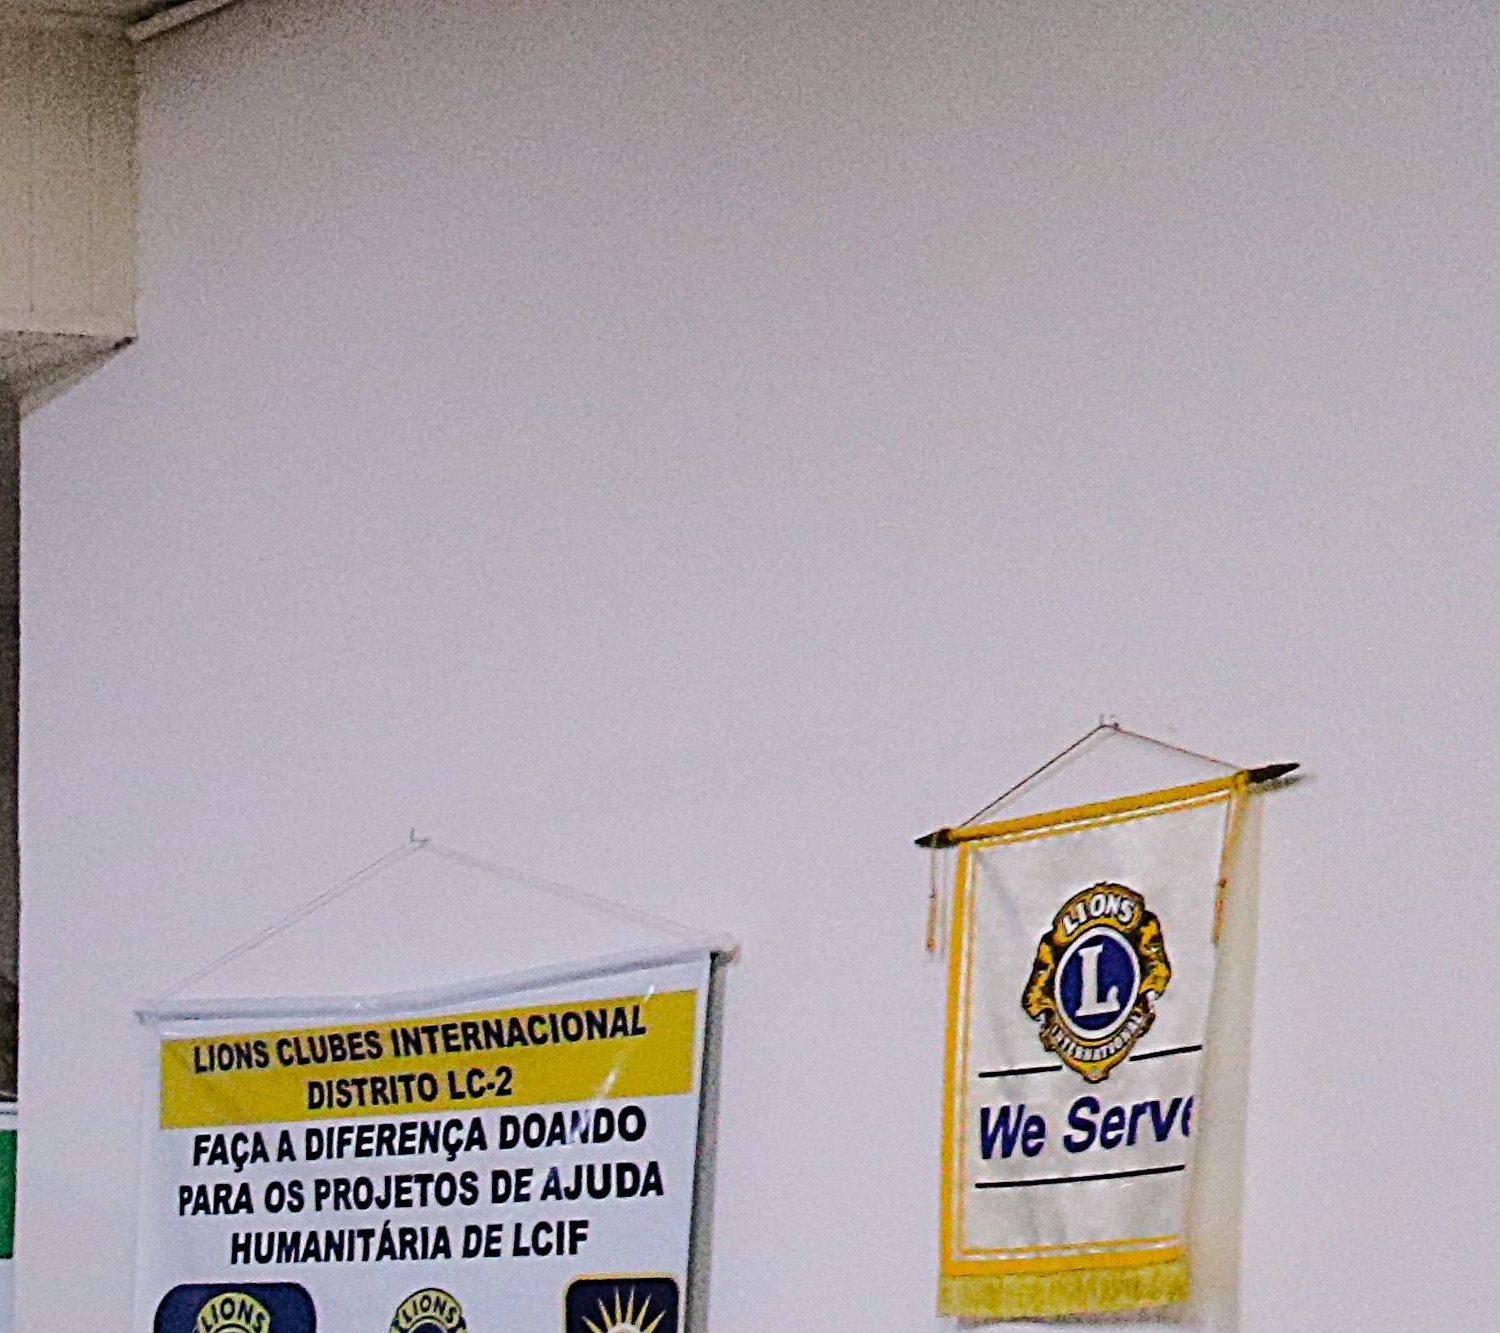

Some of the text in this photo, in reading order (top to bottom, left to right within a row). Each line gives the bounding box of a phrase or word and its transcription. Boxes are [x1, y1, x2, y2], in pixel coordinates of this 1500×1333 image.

[1062, 893, 1135, 935] LIONS
[1075, 943, 1120, 1018] L
[194, 1004, 647, 1074] LIONS CLUBES INTERNACIONAL
[307, 1066, 513, 1110] DISTRITO LC-2
[193, 1104, 647, 1173] FAÇA A DIFERENÇA DOANDO
[980, 1103, 1046, 1160] We
[178, 1161, 664, 1217] PARA OS PROJETOS DE AJUDA
[230, 1219, 590, 1265] HUMANITÁRIA DE LCIF
[201, 1297, 267, 1333] LIONS
[402, 1295, 457, 1322] LIONS
